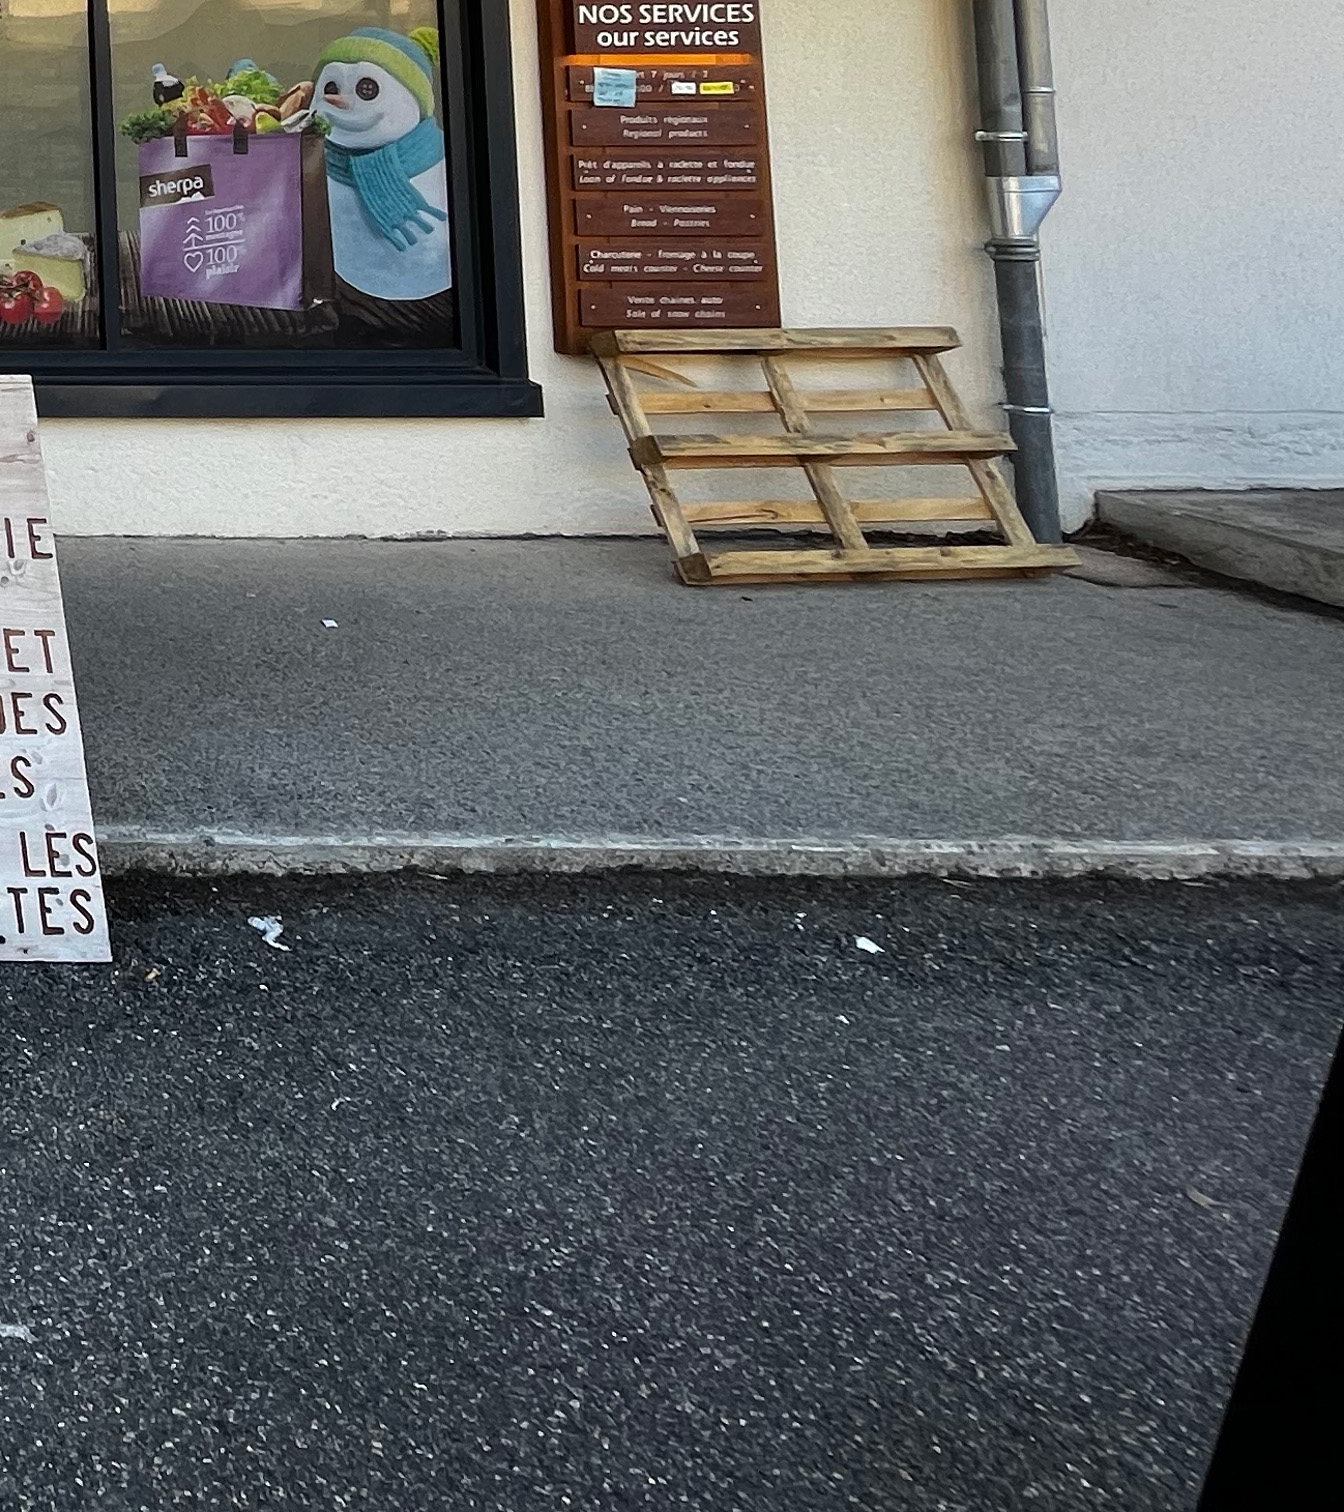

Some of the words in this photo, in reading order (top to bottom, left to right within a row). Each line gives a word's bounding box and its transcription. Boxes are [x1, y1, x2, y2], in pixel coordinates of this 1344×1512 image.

[578, 4, 633, 24] NOS
[639, 3, 754, 24] SERVICES
[596, 30, 639, 47] our
[644, 27, 739, 47] services
[148, 176, 204, 198] sherpa
[3, 629, 56, 674] ET
[19, 830, 97, 880] LES
